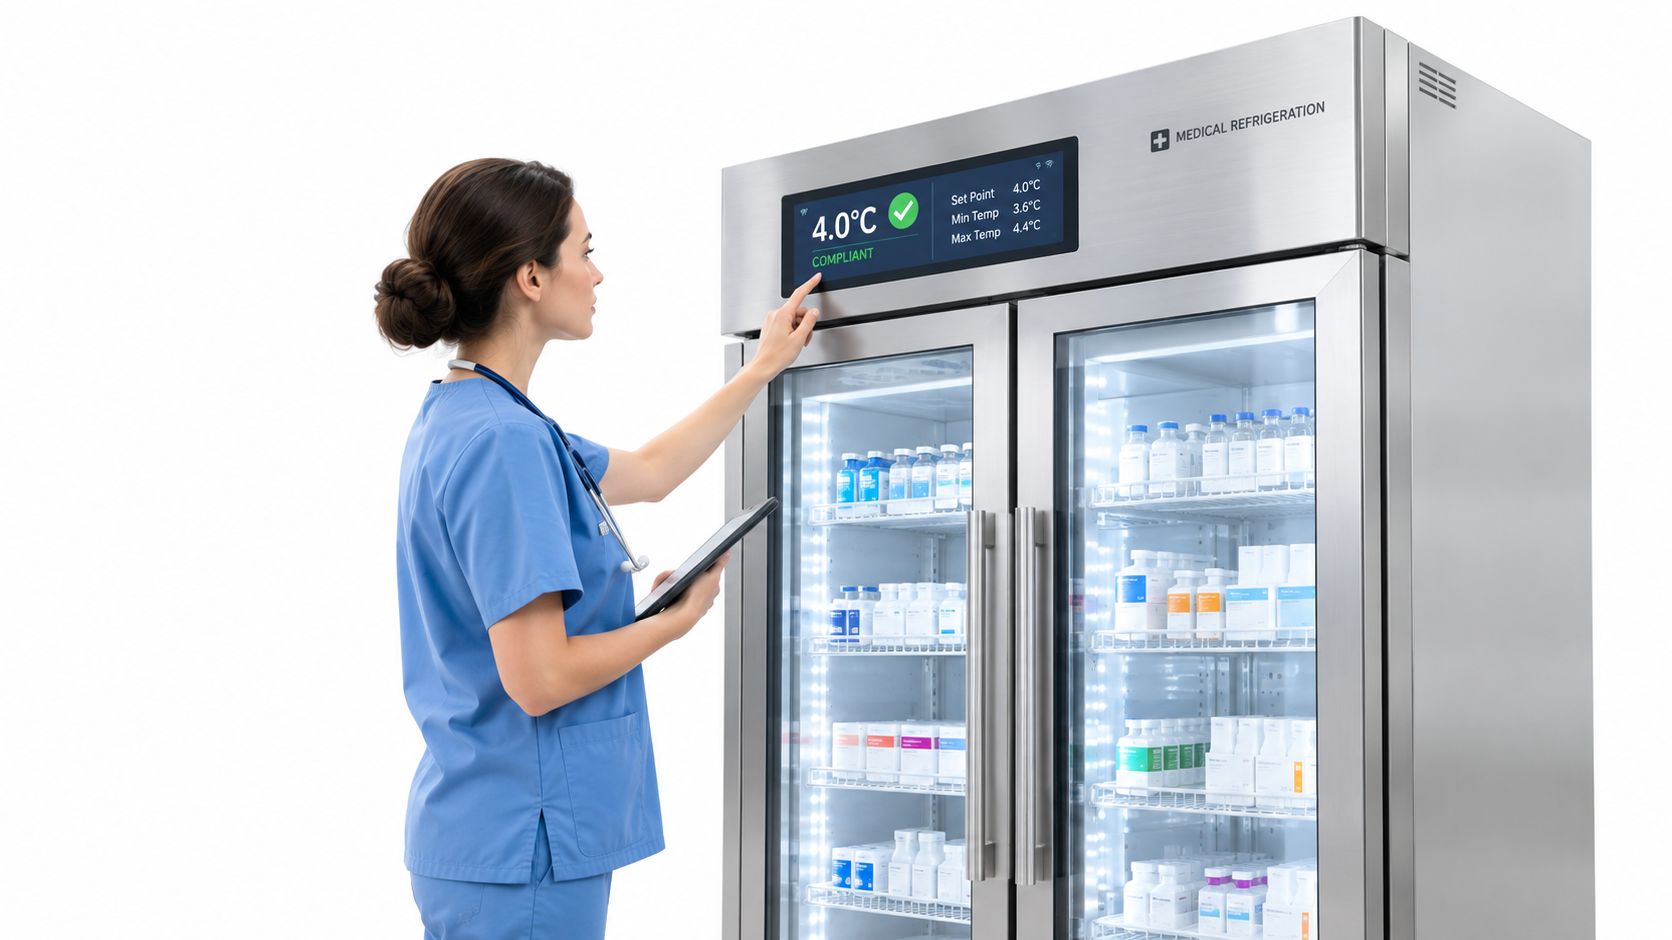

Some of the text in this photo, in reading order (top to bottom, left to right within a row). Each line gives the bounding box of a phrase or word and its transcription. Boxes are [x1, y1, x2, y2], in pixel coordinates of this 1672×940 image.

[1176, 101, 1325, 142] MEDICAL REFRIGERATION
[951, 178, 1041, 206] Set Point 4.0°C
[812, 206, 877, 242] 4.0°C
[951, 199, 1041, 225] Min Temp 3.6°C
[951, 219, 1041, 245] Max Temp 4.4°C
[812, 247, 874, 268] COMPLIANT
